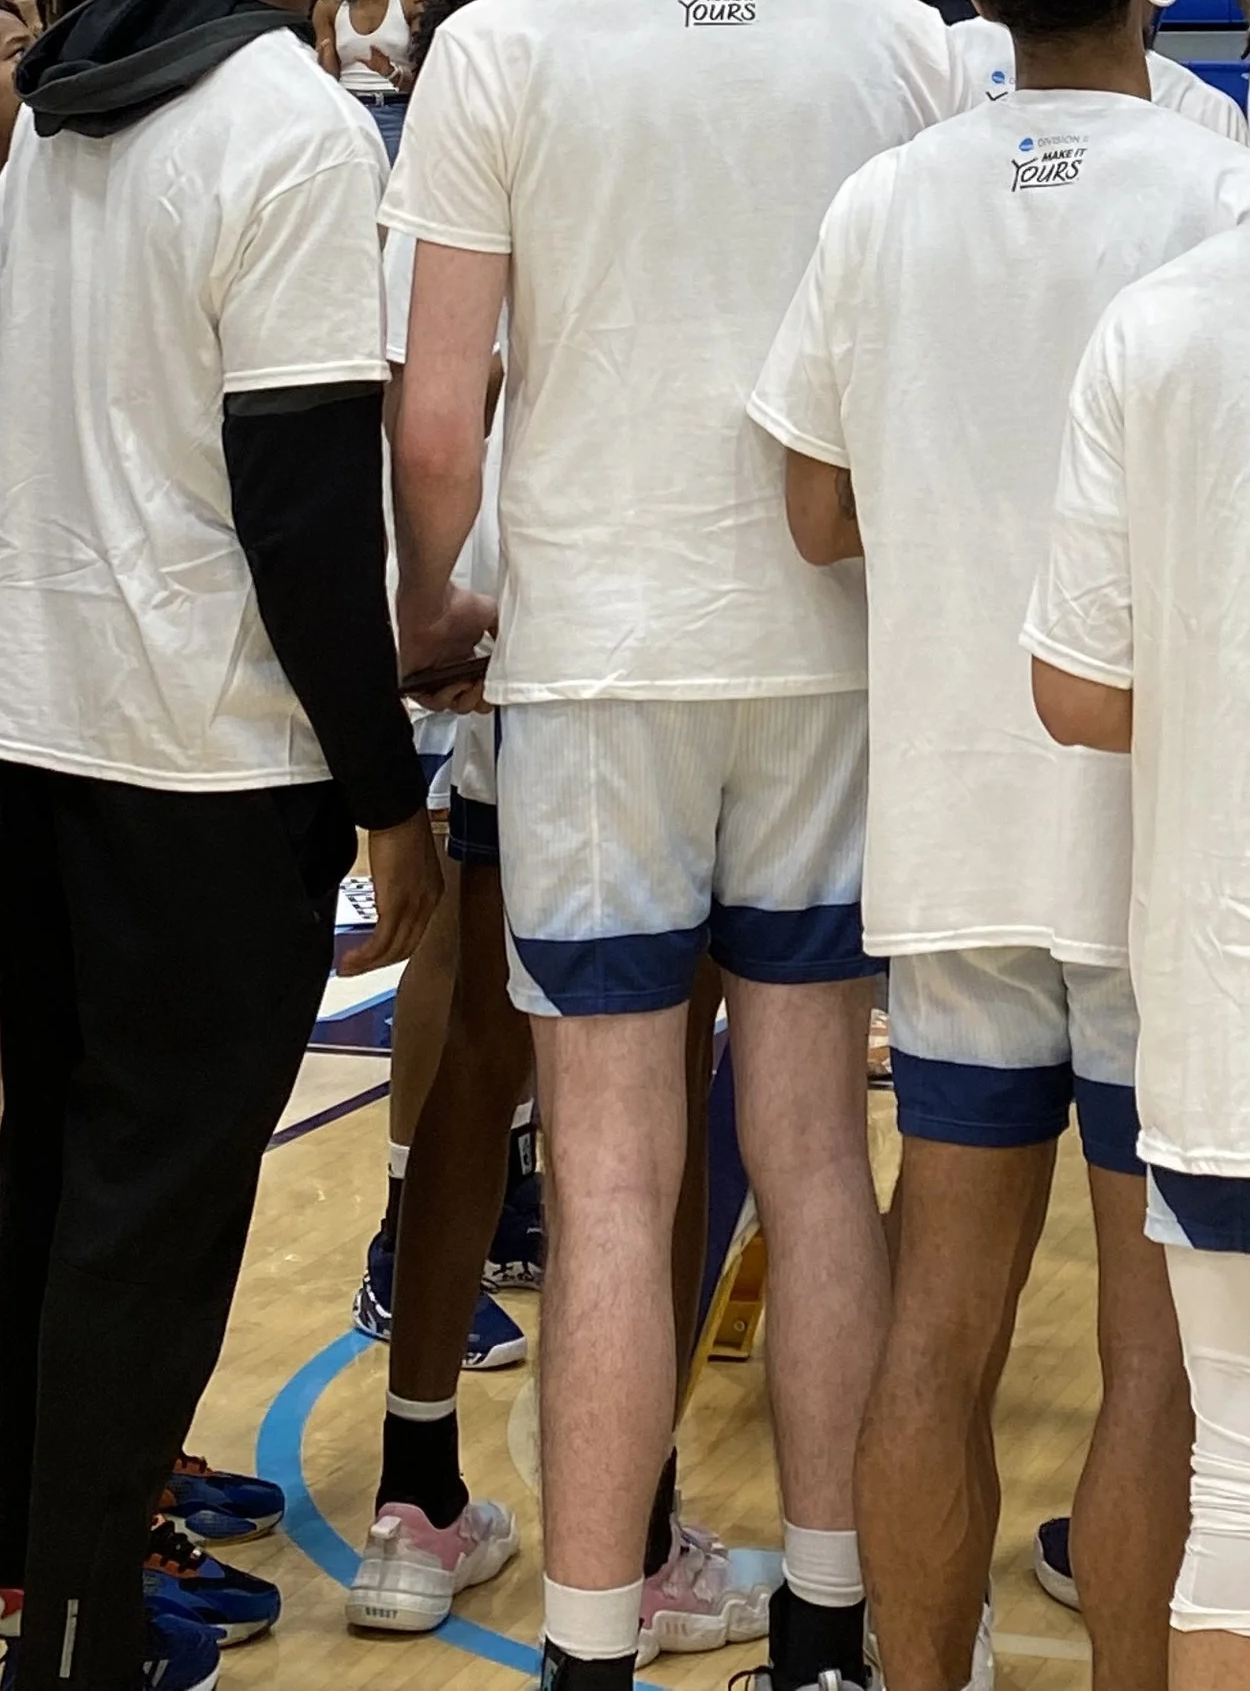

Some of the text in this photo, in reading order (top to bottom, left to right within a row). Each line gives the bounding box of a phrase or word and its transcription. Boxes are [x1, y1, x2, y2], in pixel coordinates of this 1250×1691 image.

[1041, 148, 1088, 162] MAKE IT
[1011, 158, 1082, 192] YOURS
